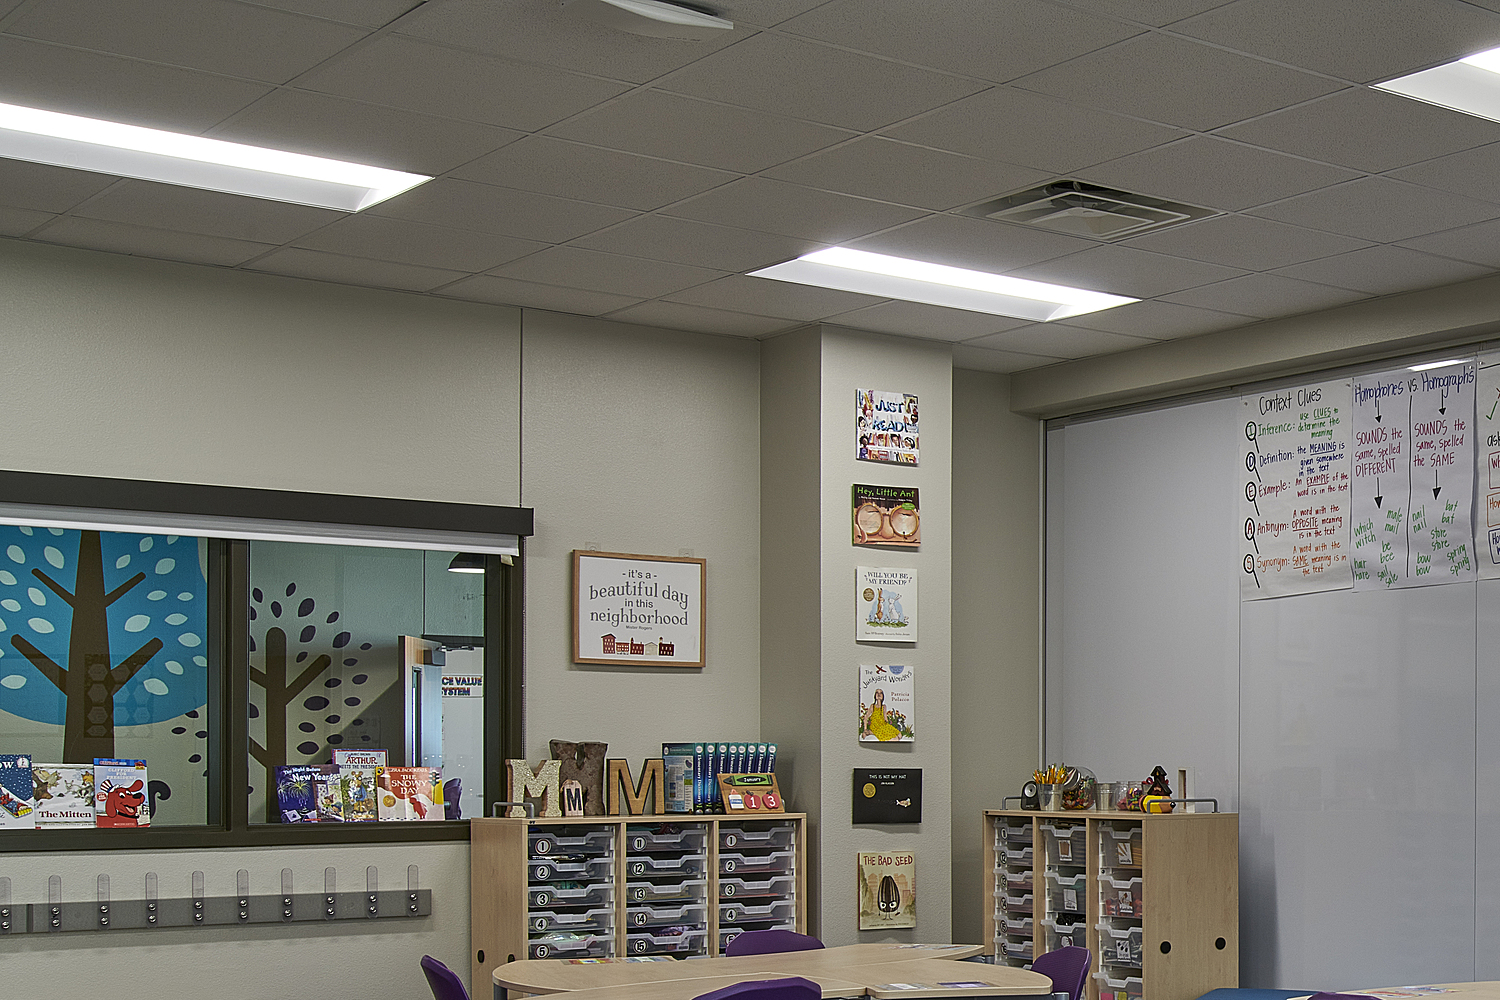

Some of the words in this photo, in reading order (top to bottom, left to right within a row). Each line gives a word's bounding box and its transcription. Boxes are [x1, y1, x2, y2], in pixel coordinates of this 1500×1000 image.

[1354, 380, 1404, 407] Homophones
[1421, 367, 1475, 398] Homographs
[875, 400, 904, 413] JUST
[1259, 392, 1291, 416] Context
[1297, 387, 1322, 407] Clues
[1258, 422, 1296, 437] Inference:
[1356, 431, 1387, 446] SOUNDS
[1392, 428, 1403, 441] the
[1259, 451, 1295, 468] Definition:
[1378, 445, 1401, 459] spelled
[1355, 459, 1396, 477] DIFFERENT
[857, 487, 874, 496] Hey,
[876, 489, 897, 497] Little
[1258, 482, 1290, 499] Example:
[628, 570, 642, 578] it's
[589, 581, 658, 600] beautiful
[662, 585, 688, 610] day
[625, 599, 633, 607] in
[636, 599, 654, 608] this
[590, 608, 688, 627] neighborhood
[455, 677, 482, 686] VALUE
[505, 759, 562, 817] M
[607, 758, 665, 815] M
[750, 796, 756, 807] 1
[769, 796, 775, 806] 3
[864, 856, 875, 866] THE
[878, 855, 892, 866] BAD
[895, 855, 913, 866] SEED
